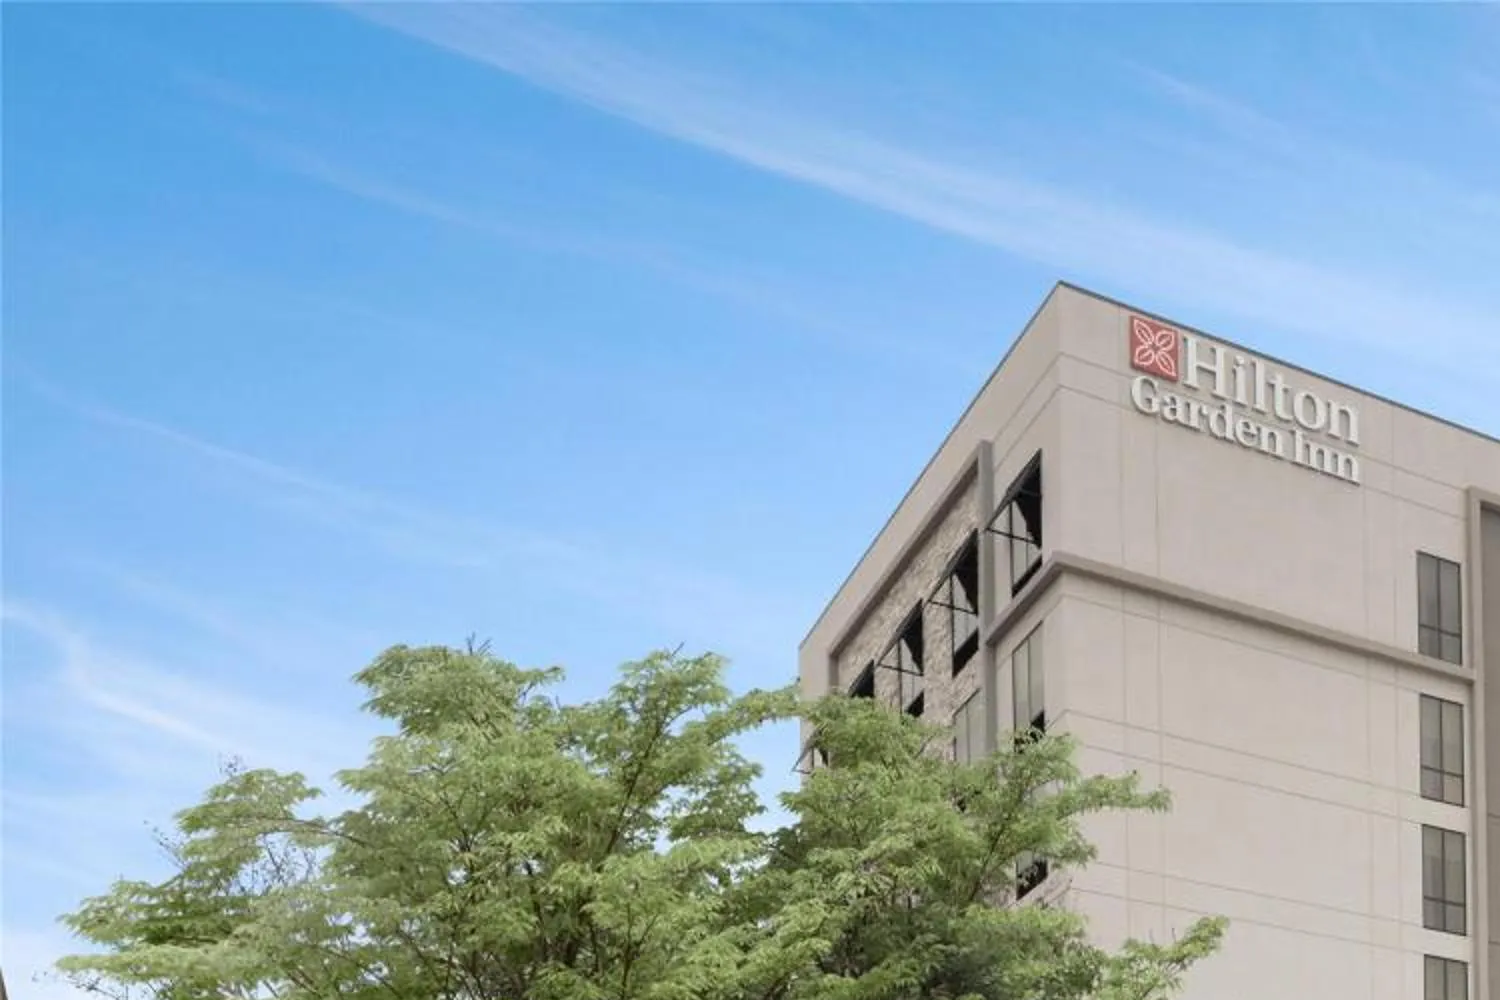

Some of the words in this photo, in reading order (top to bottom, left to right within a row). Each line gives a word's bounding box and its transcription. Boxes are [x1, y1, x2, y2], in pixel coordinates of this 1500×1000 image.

[1130, 375, 1285, 459] Garden
[1291, 428, 1361, 485] Inn
[1183, 334, 1360, 447] Hilton
